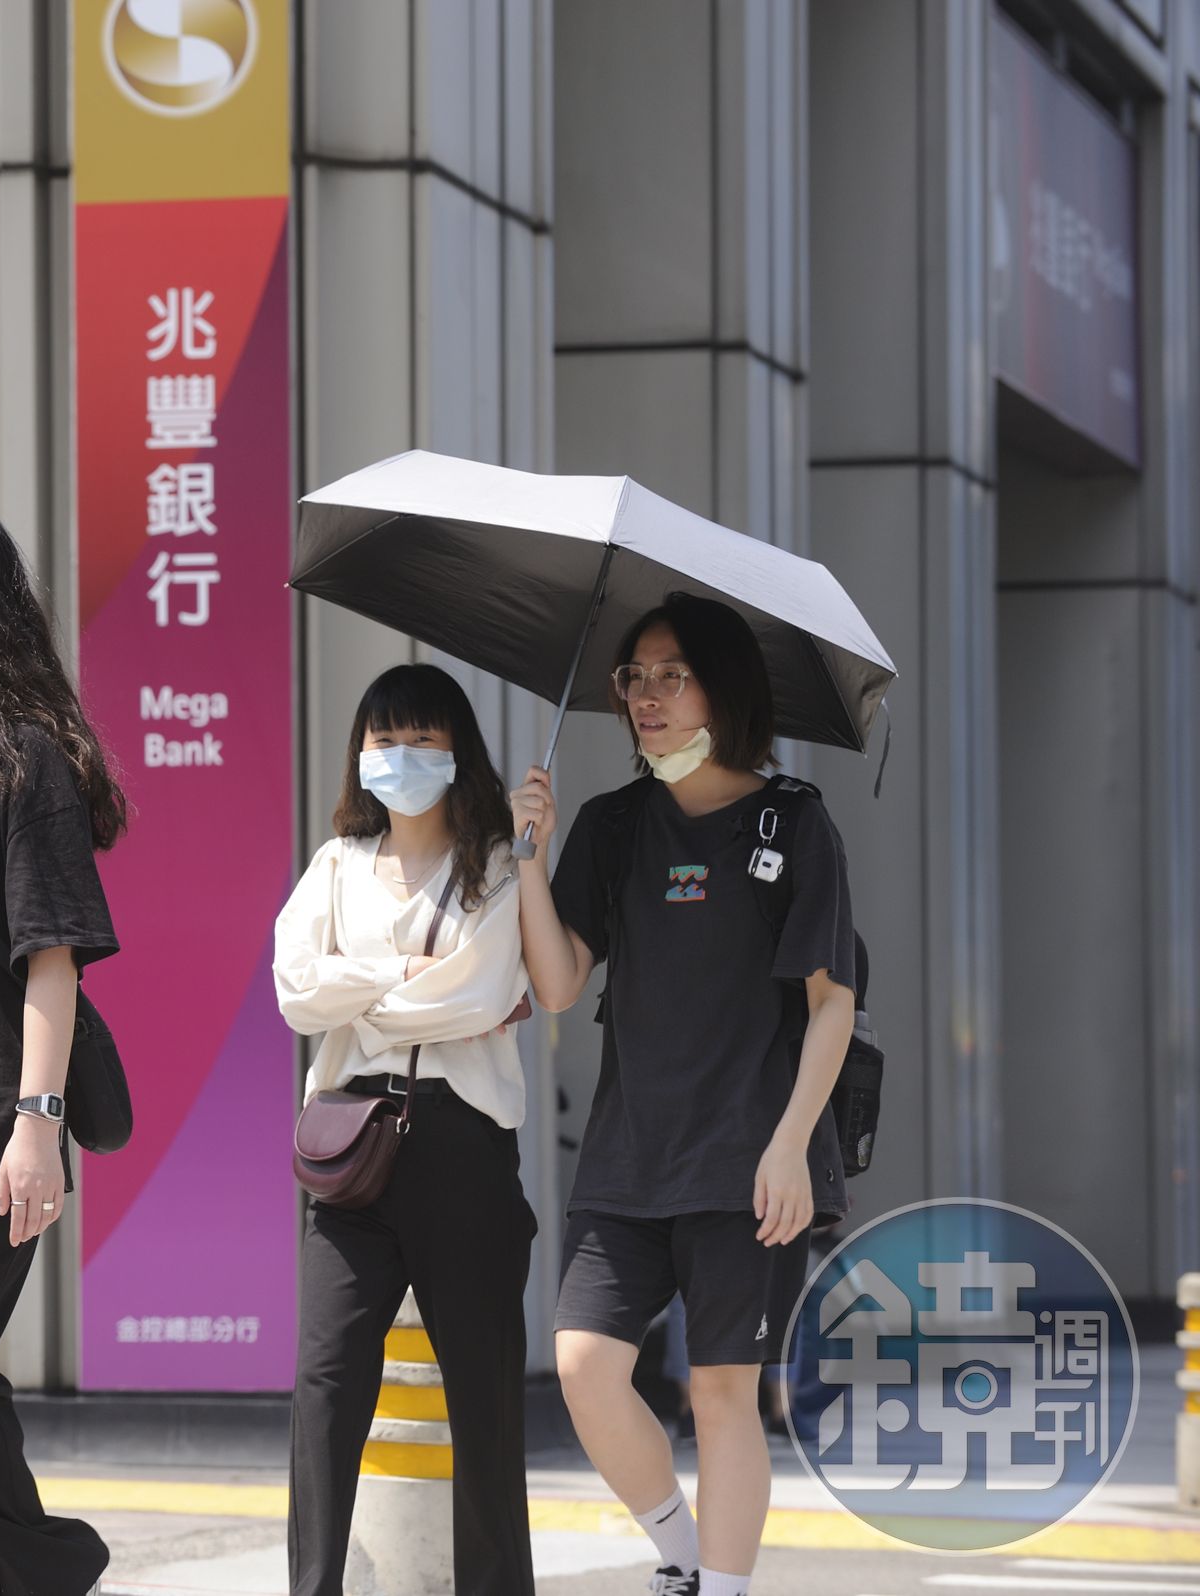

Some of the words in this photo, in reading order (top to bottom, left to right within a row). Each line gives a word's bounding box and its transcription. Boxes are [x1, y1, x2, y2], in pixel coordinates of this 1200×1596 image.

[145, 286, 221, 628] 兆豐銀行
[139, 685, 228, 727] Mega
[144, 732, 223, 767] Bank
